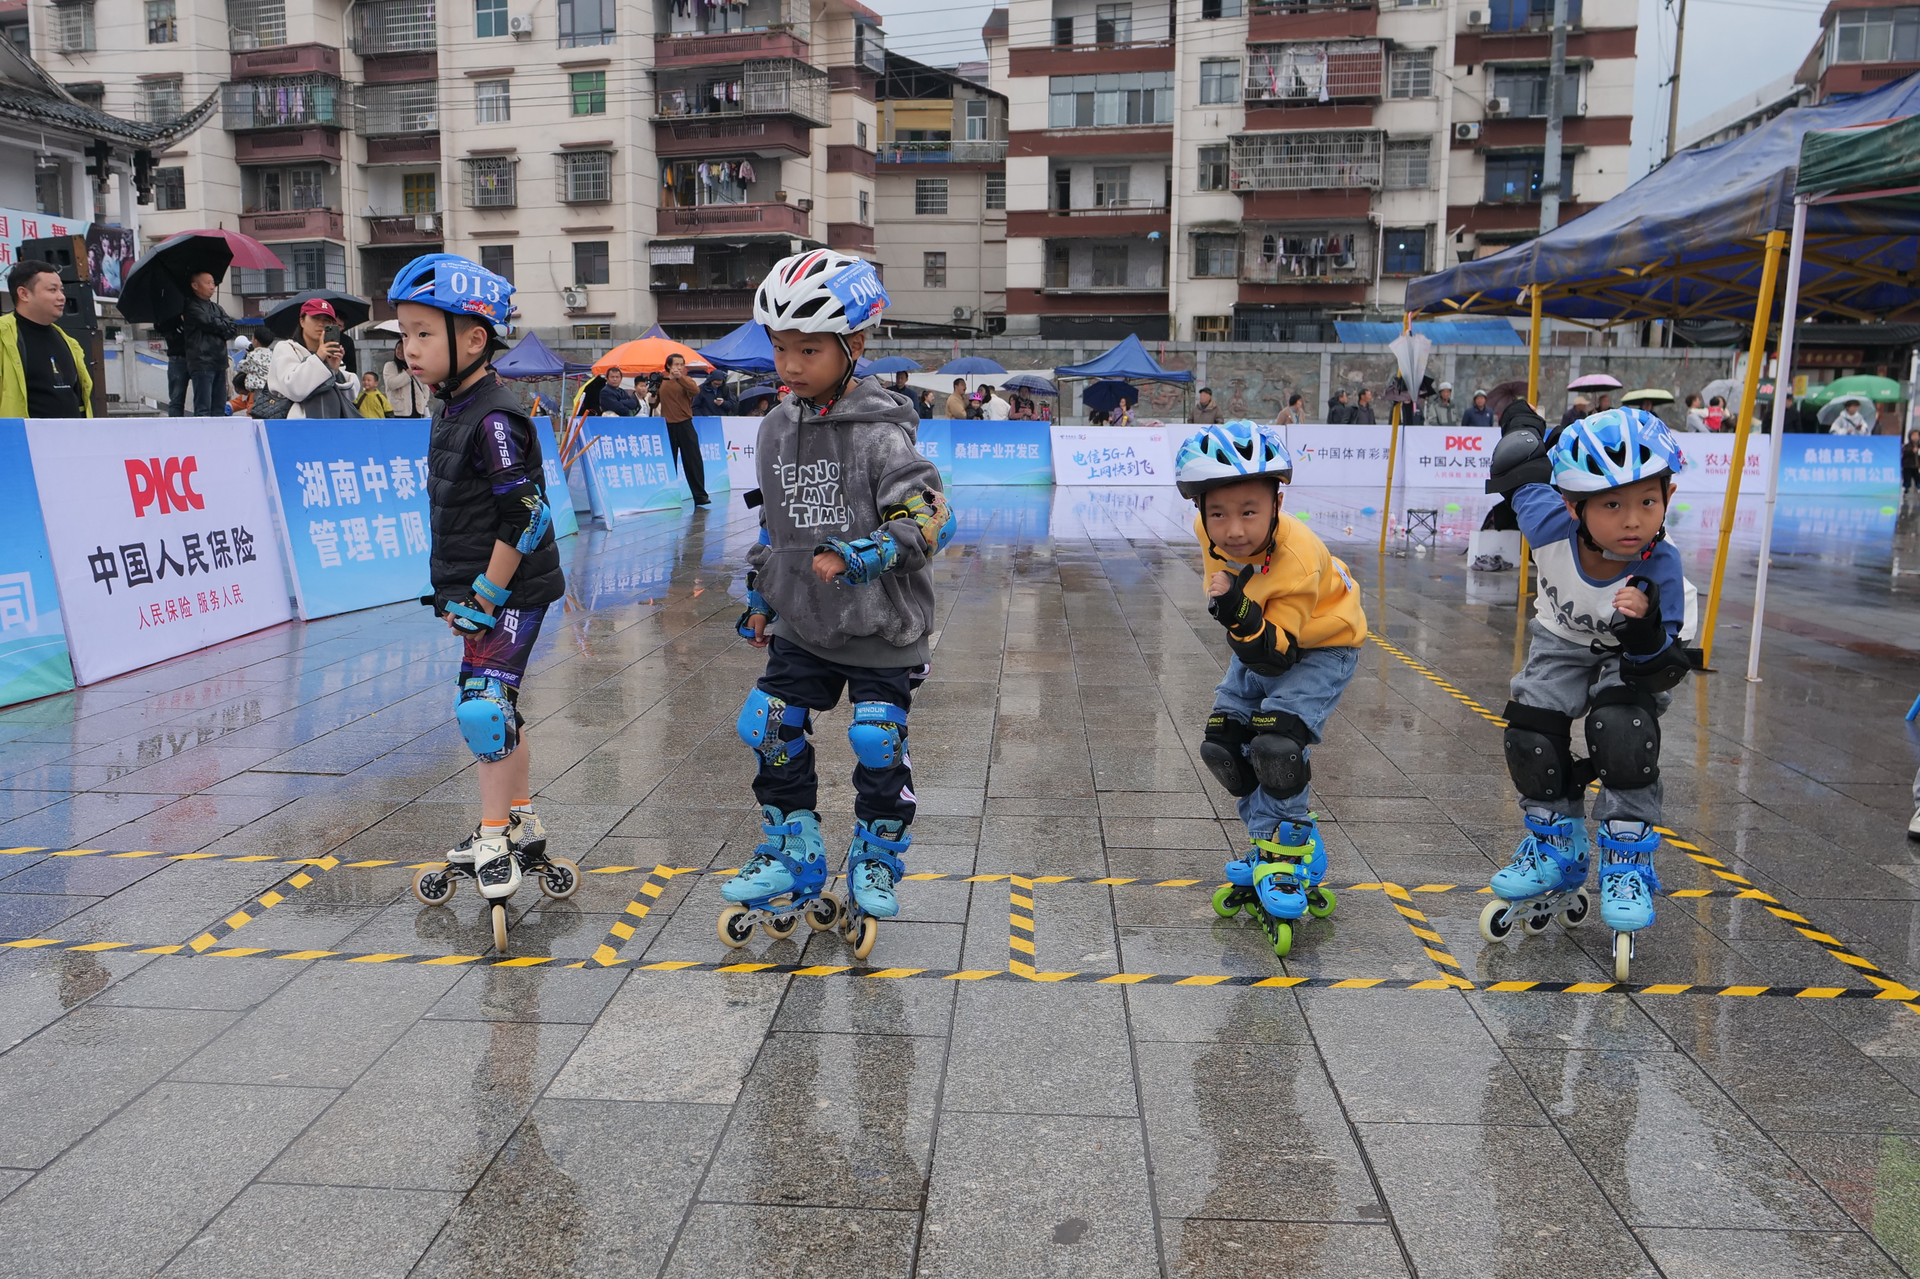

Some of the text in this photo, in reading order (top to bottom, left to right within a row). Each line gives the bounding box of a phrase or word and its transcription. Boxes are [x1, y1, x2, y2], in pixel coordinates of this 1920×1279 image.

[451, 272, 500, 303] 013
[494, 421, 512, 468] Bonse
[743, 444, 754, 458] 中
[955, 443, 1040, 459] 桑植产业开发区
[1445, 436, 1482, 450] PICC
[1705, 453, 1760, 467] 农夫泉
[1804, 448, 1874, 464] 桑植县天合
[781, 460, 842, 489] ENJO
[1087, 459, 1155, 479] 上网快到飞
[1784, 467, 1896, 482] 汽车维修有限公司
[124, 456, 205, 518] PICC
[802, 482, 839, 505] MY
[789, 504, 847, 528] TIME
[308, 511, 430, 569] 管理有限
[87, 525, 257, 595] 中国人民保险
[138, 584, 244, 630] 人民保险 服务人民
